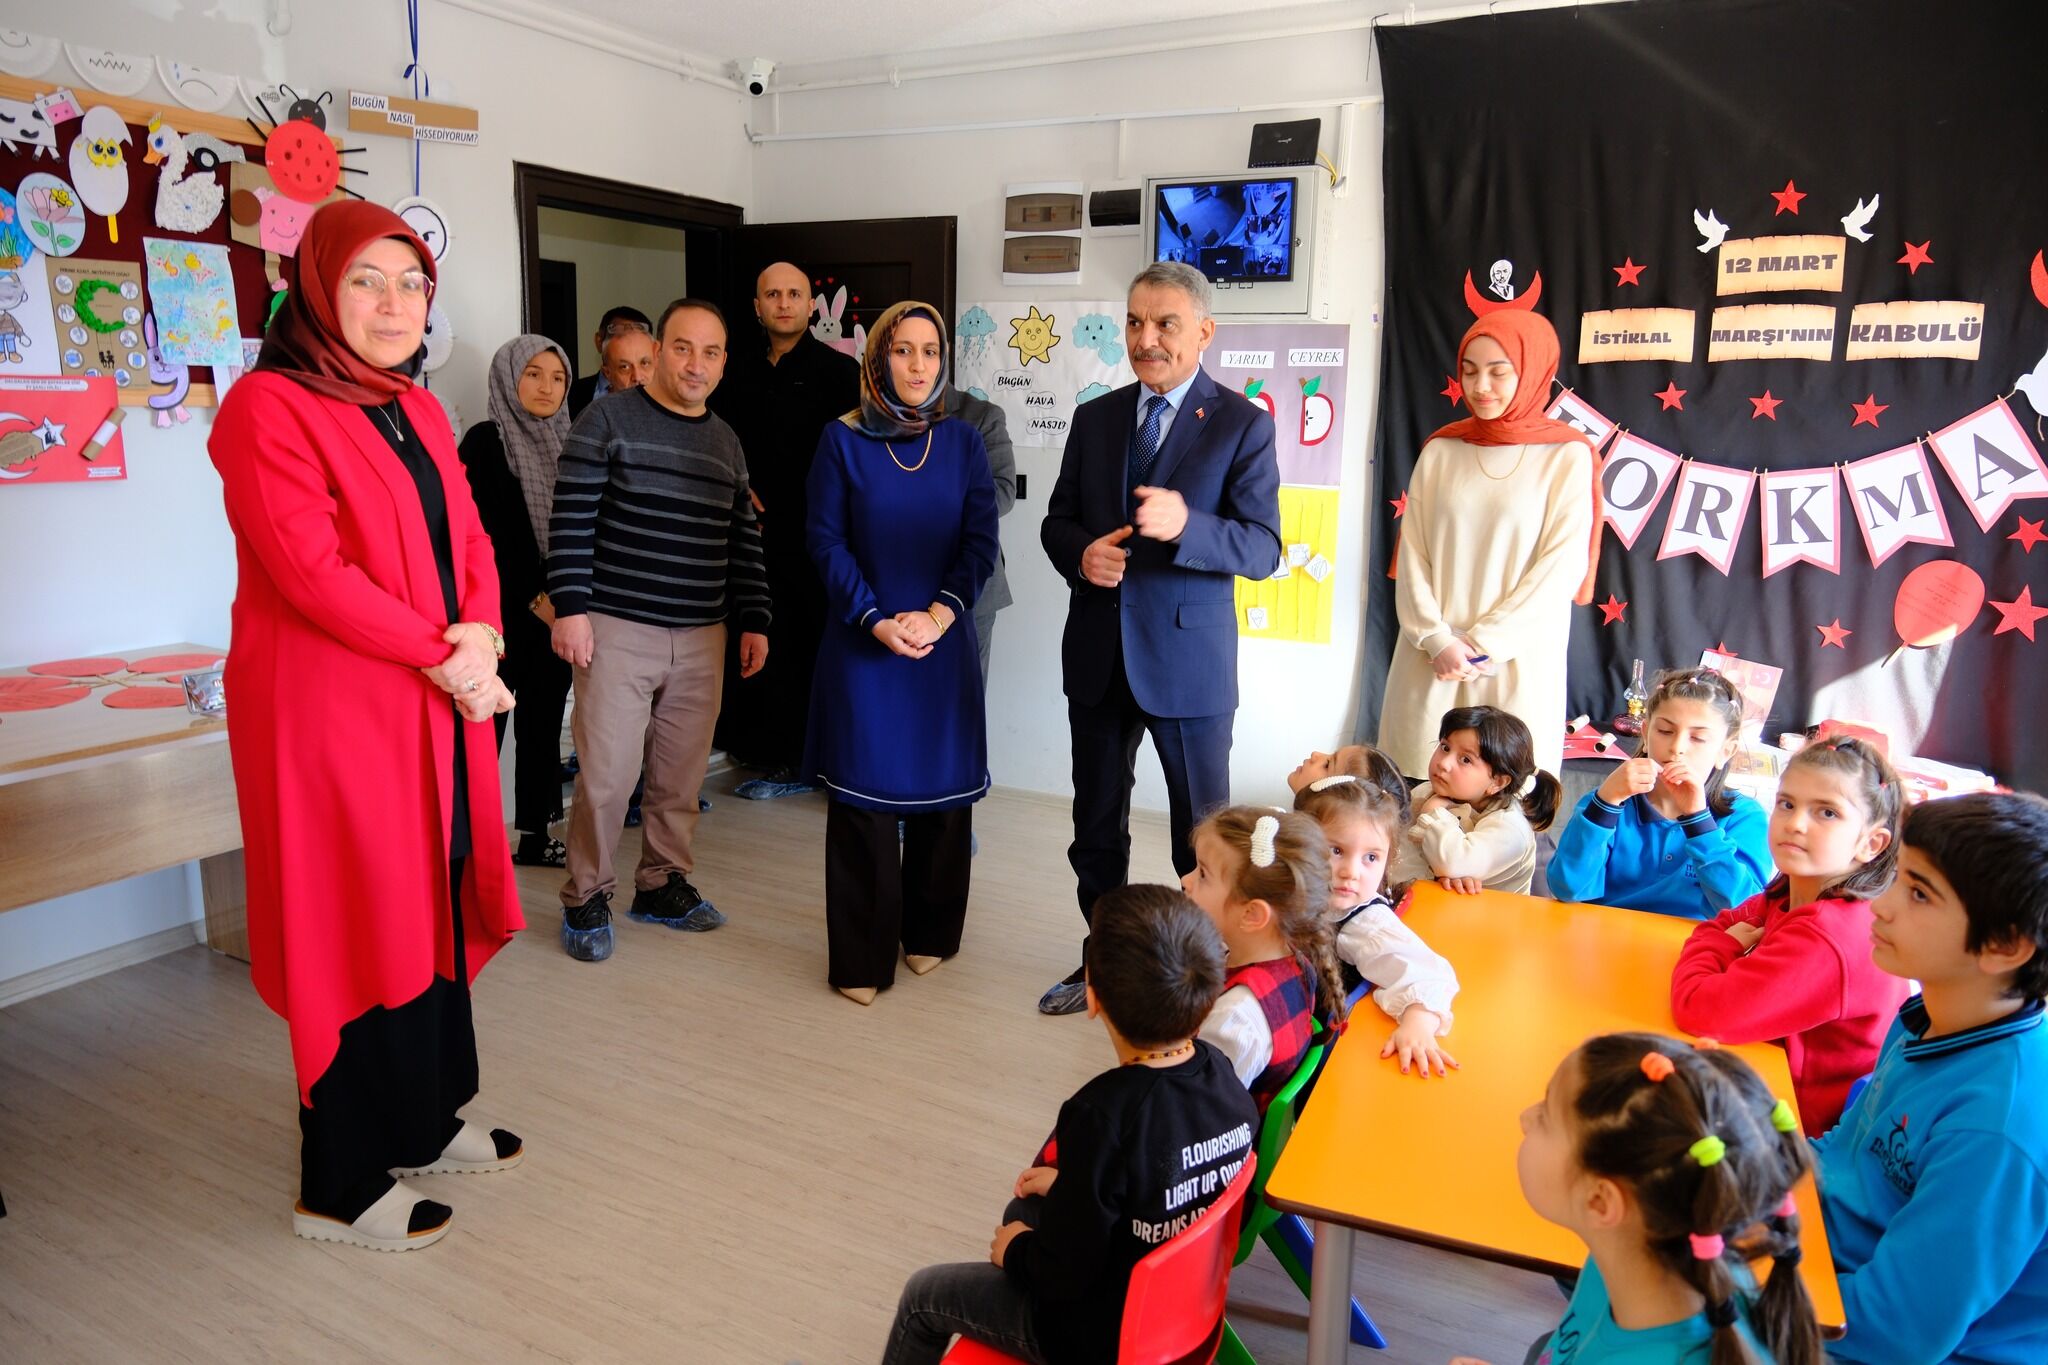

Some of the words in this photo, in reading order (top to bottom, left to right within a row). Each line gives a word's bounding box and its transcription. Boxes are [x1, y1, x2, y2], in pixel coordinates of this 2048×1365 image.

[351, 96, 385, 109] BUGÜN
[389, 112, 414, 125] NASIL
[415, 125, 479, 143] HİSSEDİYORUM?
[1725, 257, 1752, 274] 12
[1757, 254, 1838, 273] MART
[1711, 328, 1833, 346] MARŞI'NIN
[1850, 316, 1981, 342] KABULÜ
[1228, 353, 1268, 365] YARIM
[1290, 351, 1341, 365] ÇEYREK
[997, 375, 1032, 388] BUGÜN
[1026, 396, 1054, 406] HAVA
[1181, 1122, 1252, 1171] FLOURISHING
[1165, 1176, 1200, 1211] LIGHT
[1201, 1170, 1218, 1195] UP
